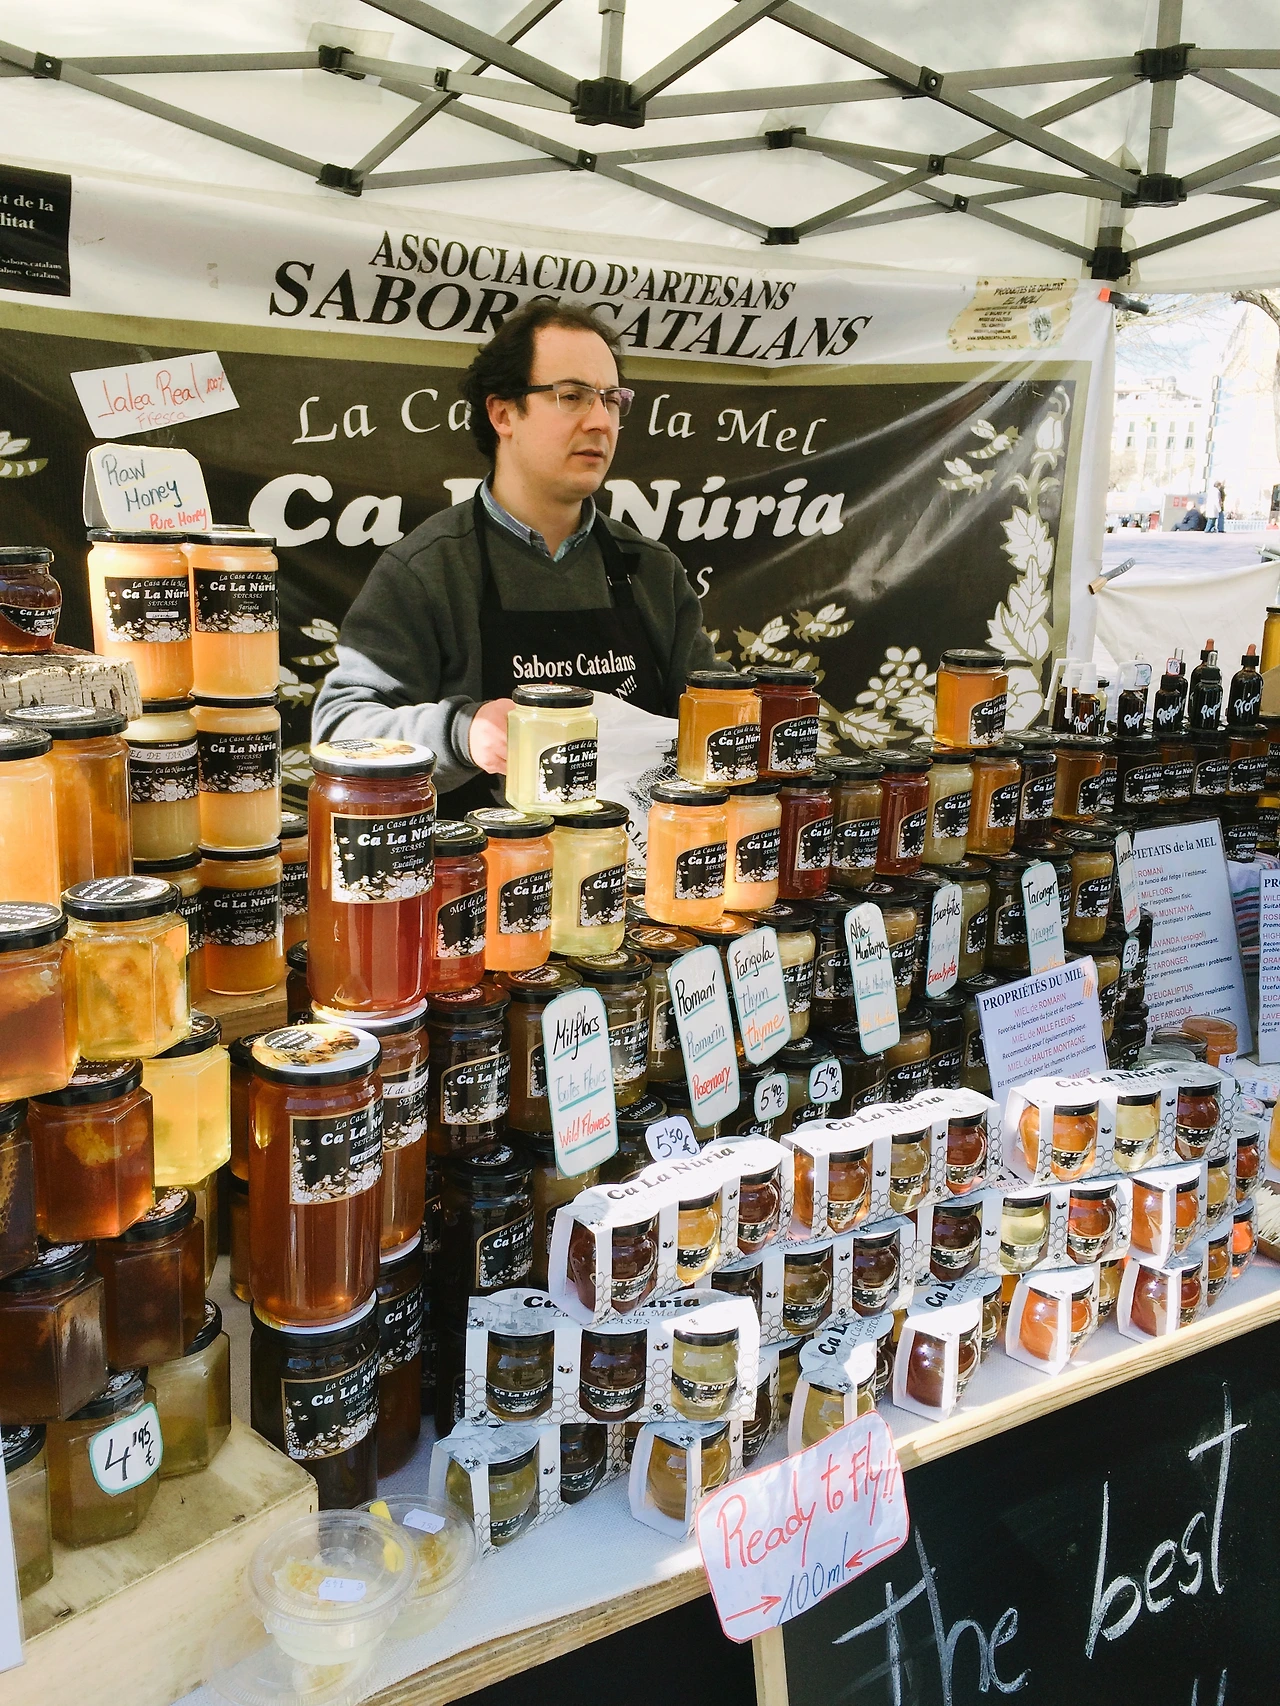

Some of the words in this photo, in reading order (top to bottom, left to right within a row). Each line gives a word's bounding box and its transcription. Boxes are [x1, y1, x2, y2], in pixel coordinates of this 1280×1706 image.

[14, 195, 34, 208] de
[39, 198, 54, 212] la
[25, 270, 60, 280] Catalans
[369, 230, 597, 295] ASSOCIACIO
[600, 262, 797, 311] D'ARTESANS
[98, 373, 154, 418] Jalea
[156, 363, 205, 406] Real
[135, 411, 190, 429] Fresca
[291, 396, 378, 444] La
[648, 394, 696, 439] la
[717, 407, 828, 457] Mel
[101, 454, 146, 486] Raw
[124, 480, 182, 512] Honey
[150, 514, 175, 530] Pure
[178, 509, 207, 530] Honey
[248, 474, 404, 547] Ca
[604, 476, 846, 543] Núria
[122, 589, 142, 600] Ca
[144, 589, 163, 599] La
[132, 581, 142, 589] La
[143, 580, 161, 588] Casa
[161, 579, 170, 587] de
[209, 581, 227, 592] Ca
[229, 582, 248, 592] La
[250, 581, 277, 592] Núria
[512, 655, 573, 679] Sabors
[576, 650, 636, 676] Catalans
[210, 744, 226, 753] Ca
[229, 744, 246, 754] La
[249, 742, 278, 753] Núria
[551, 753, 567, 764] Ca
[568, 752, 580, 763] La
[371, 822, 384, 833] La
[386, 819, 407, 831] Casa
[408, 816, 418, 827] de
[357, 833, 383, 847] Ca
[386, 832, 408, 846] La
[1173, 842, 1184, 853] de
[1186, 840, 1195, 851] la
[1196, 837, 1217, 849] MEL
[392, 857, 425, 870] Eucaliptus
[1023, 881, 1057, 906] Taronger
[449, 902, 467, 916] Mel
[467, 899, 476, 910] de
[1161, 904, 1195, 917] MUNTANYA
[850, 915, 870, 945] Alta
[734, 936, 775, 980] Farigola
[1154, 955, 1189, 970] TARONGER
[675, 971, 717, 1017] Romaní
[982, 980, 1047, 1011] PROPRIÉTÉS
[1049, 974, 1063, 989] DU
[1014, 1007, 1030, 1018] MIEL
[1031, 1003, 1038, 1012] de
[1038, 993, 1067, 1009] ROMARIN
[1150, 1014, 1160, 1023] DE
[1161, 1006, 1193, 1021] FARIGOLA
[553, 1006, 600, 1060] Milflors
[686, 1023, 725, 1059] Romarin
[1011, 1034, 1027, 1045] MIEL
[1028, 1030, 1036, 1039] de
[1036, 1024, 1054, 1036] MILLE
[1055, 1014, 1076, 1030] FLEURS
[1007, 1061, 1023, 1072] MIEL
[1024, 1057, 1031, 1067] de
[1032, 1050, 1052, 1063] HAUTE
[1052, 1035, 1086, 1055] MONTAGNE
[692, 1066, 731, 1101] Rosemary
[1055, 1078, 1082, 1088] Ca
[1087, 1073, 1115, 1085] La
[1115, 1064, 1178, 1080] Núria
[825, 1117, 848, 1132] Ca
[853, 1110, 885, 1126] La
[888, 1092, 945, 1115] Núria
[558, 1116, 580, 1149] Wild
[582, 1109, 611, 1136] Flowers
[682, 1136, 698, 1155] €
[607, 1184, 634, 1201] Ca
[637, 1170, 671, 1190] La
[674, 1146, 736, 1172] Núria
[311, 1393, 334, 1407] Ca
[339, 1382, 359, 1400] La
[144, 1444, 155, 1468] €
[716, 1470, 817, 1571] Ready
[820, 1453, 845, 1514] to
[1085, 1380, 1249, 1660] best
